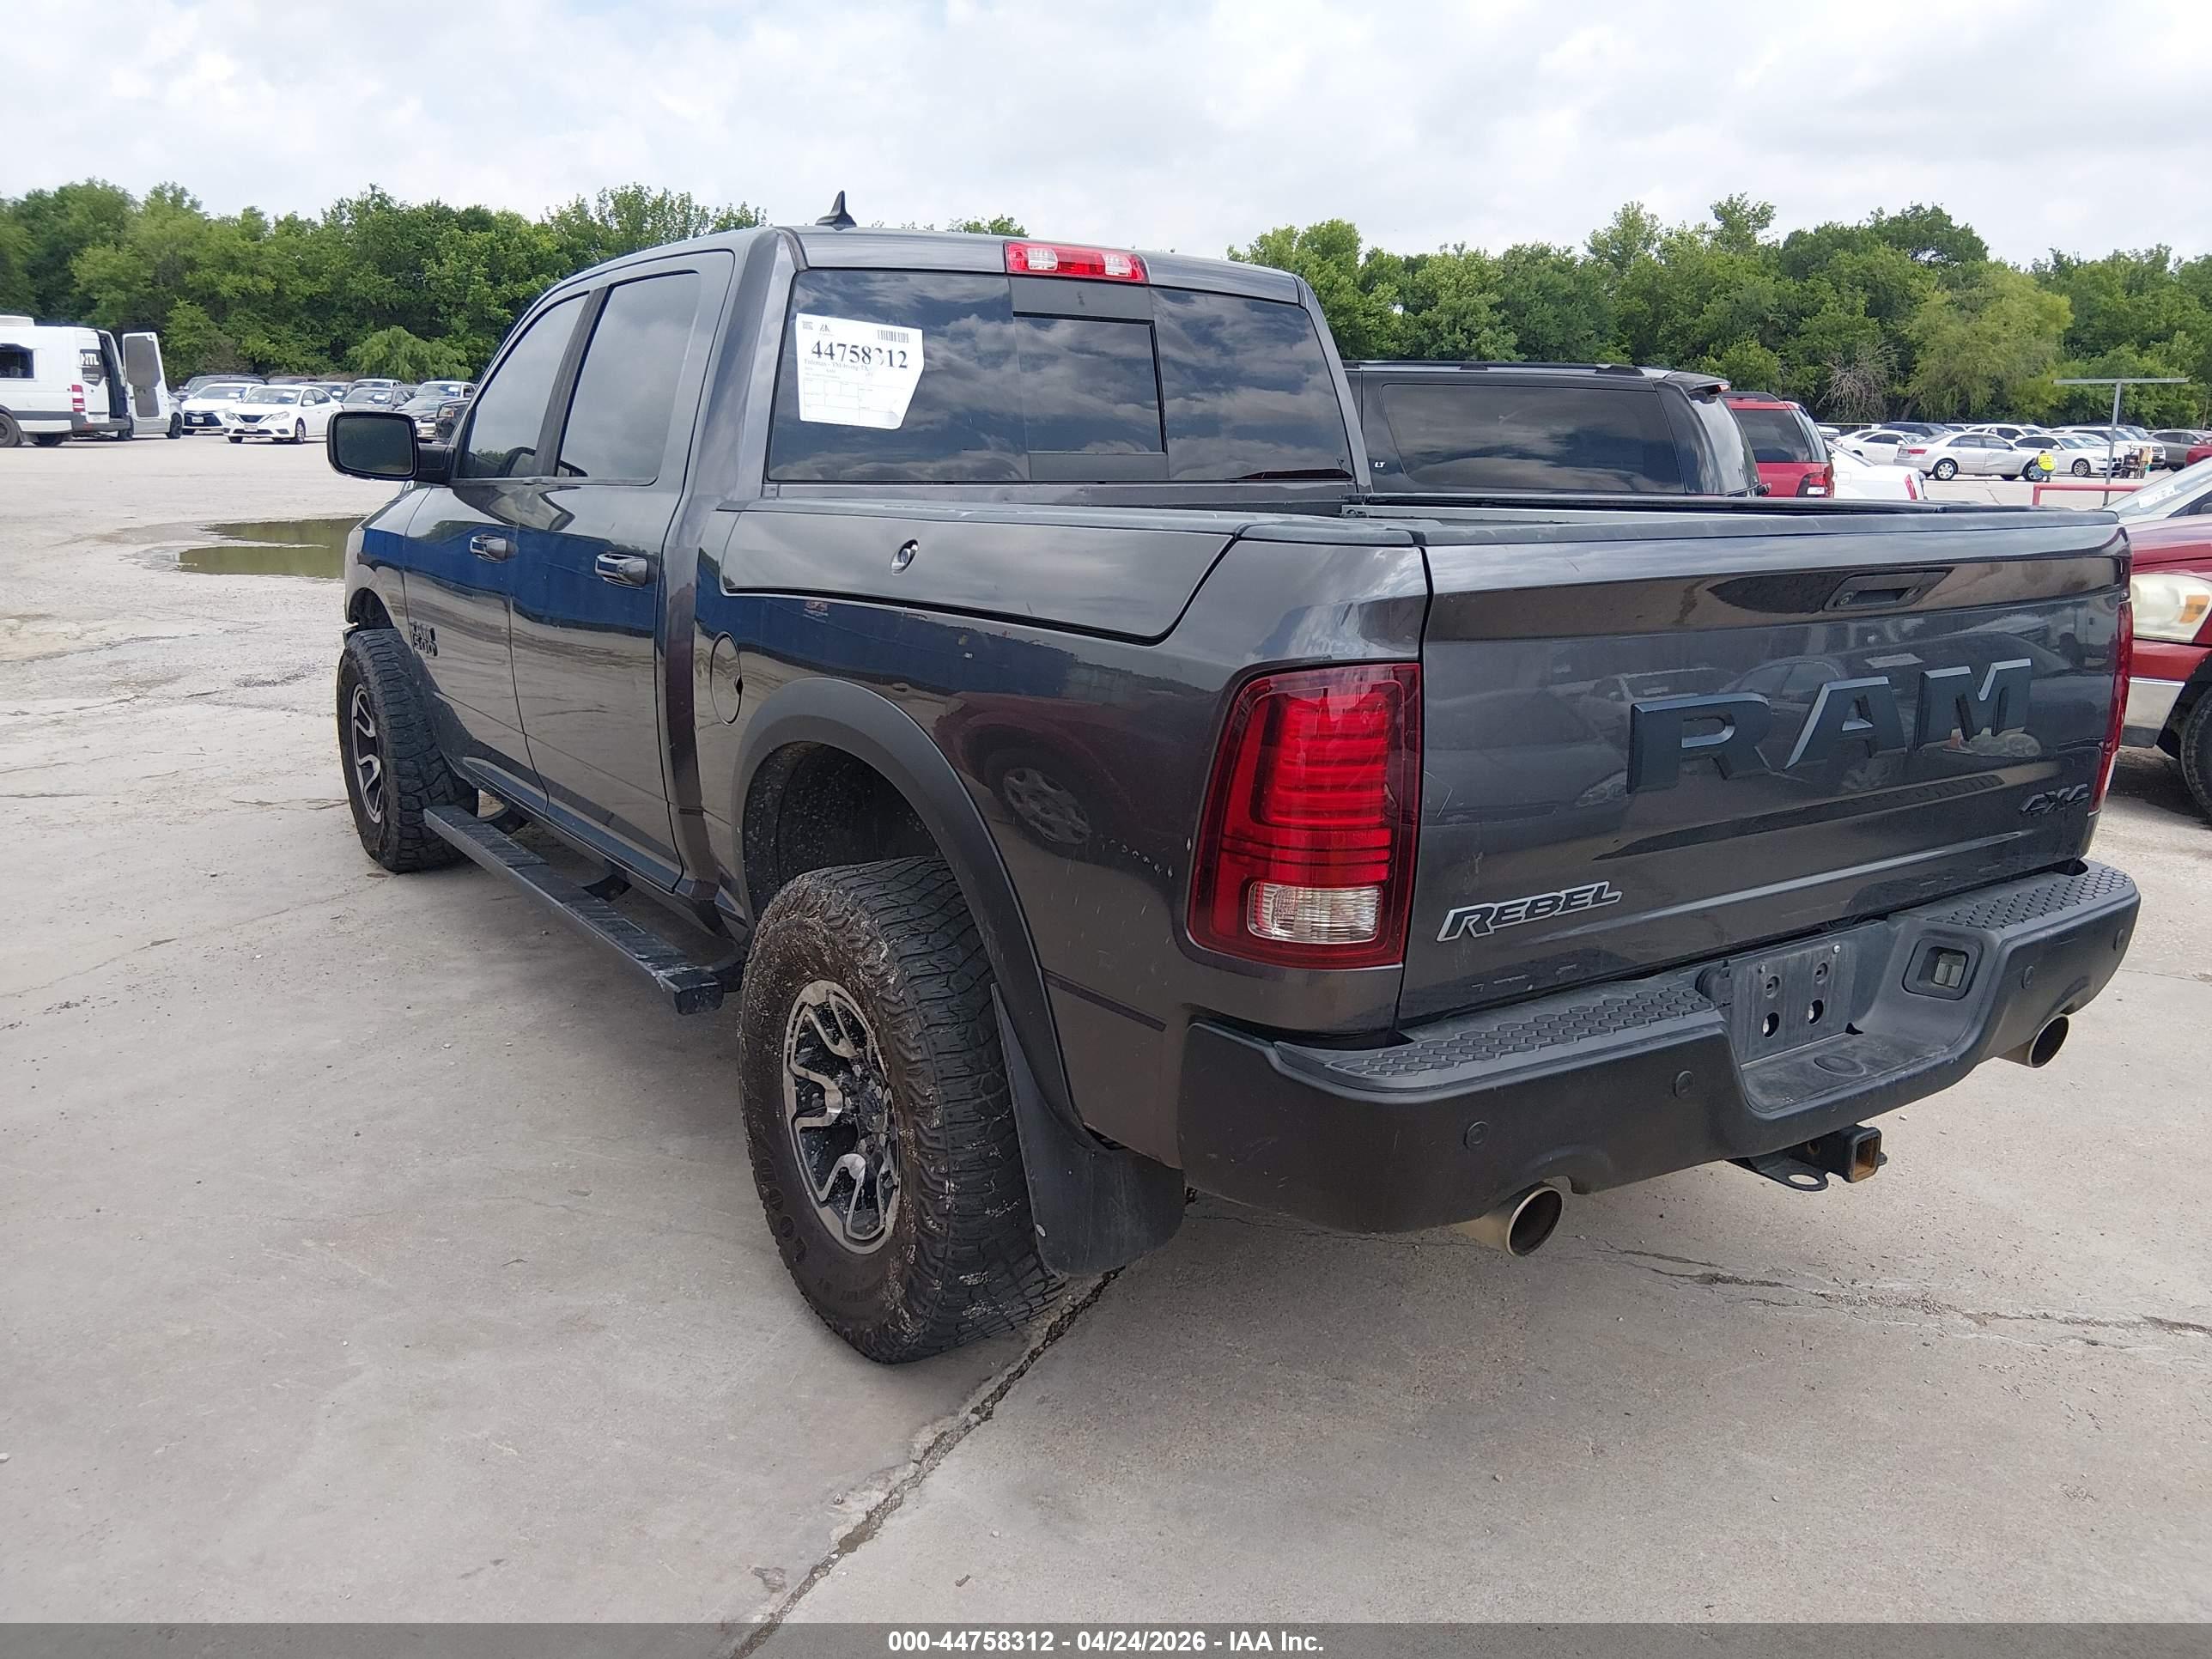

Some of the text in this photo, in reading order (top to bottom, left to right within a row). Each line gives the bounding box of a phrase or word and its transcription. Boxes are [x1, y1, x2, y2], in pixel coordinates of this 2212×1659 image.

[811, 340, 908, 368] 44758312
[1628, 658, 2033, 795] RAM
[1436, 880, 1623, 942] REBEL
